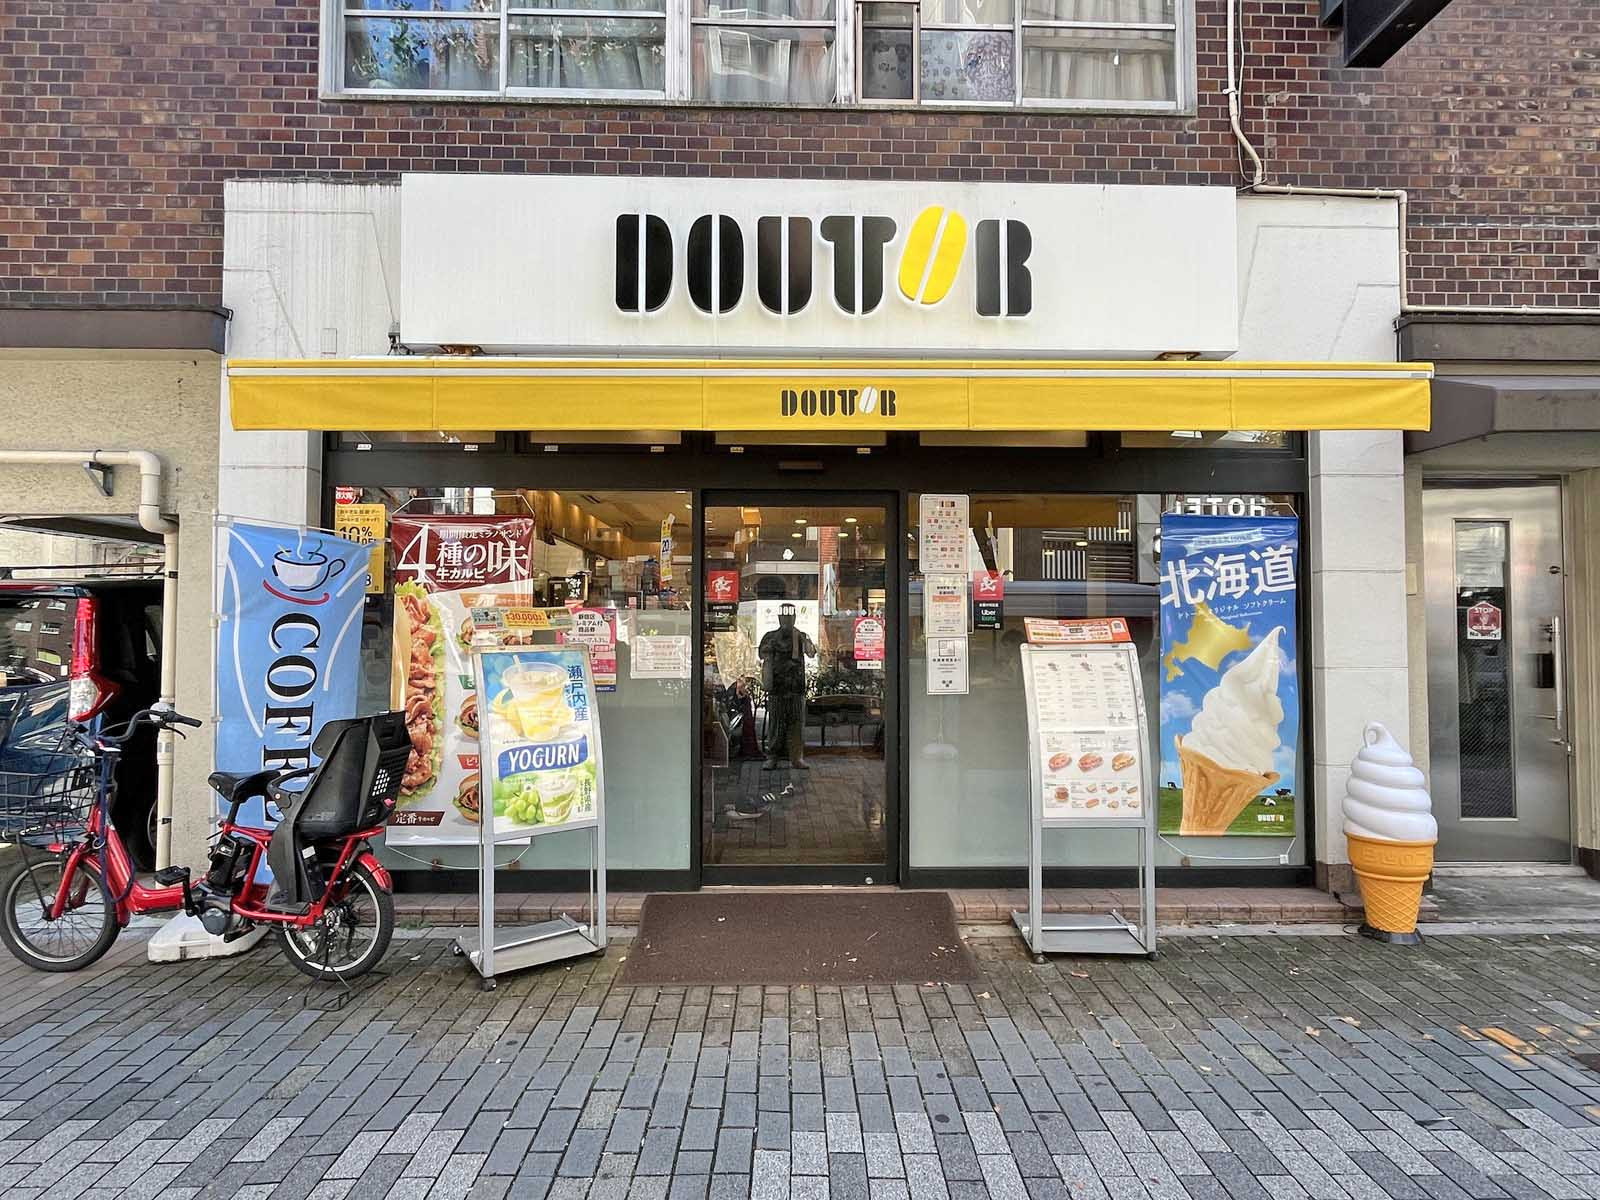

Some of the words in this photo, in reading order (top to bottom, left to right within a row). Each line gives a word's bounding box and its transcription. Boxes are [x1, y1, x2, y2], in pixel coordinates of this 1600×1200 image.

[615, 205, 1033, 318] DOUTOR
[781, 386, 896, 416] DOUTOR
[436, 567, 486, 580] 牛カルビ
[1160, 545, 1297, 609] 北海道
[567, 664, 589, 722] 瀬戸内産
[508, 743, 580, 772] YOGURN
